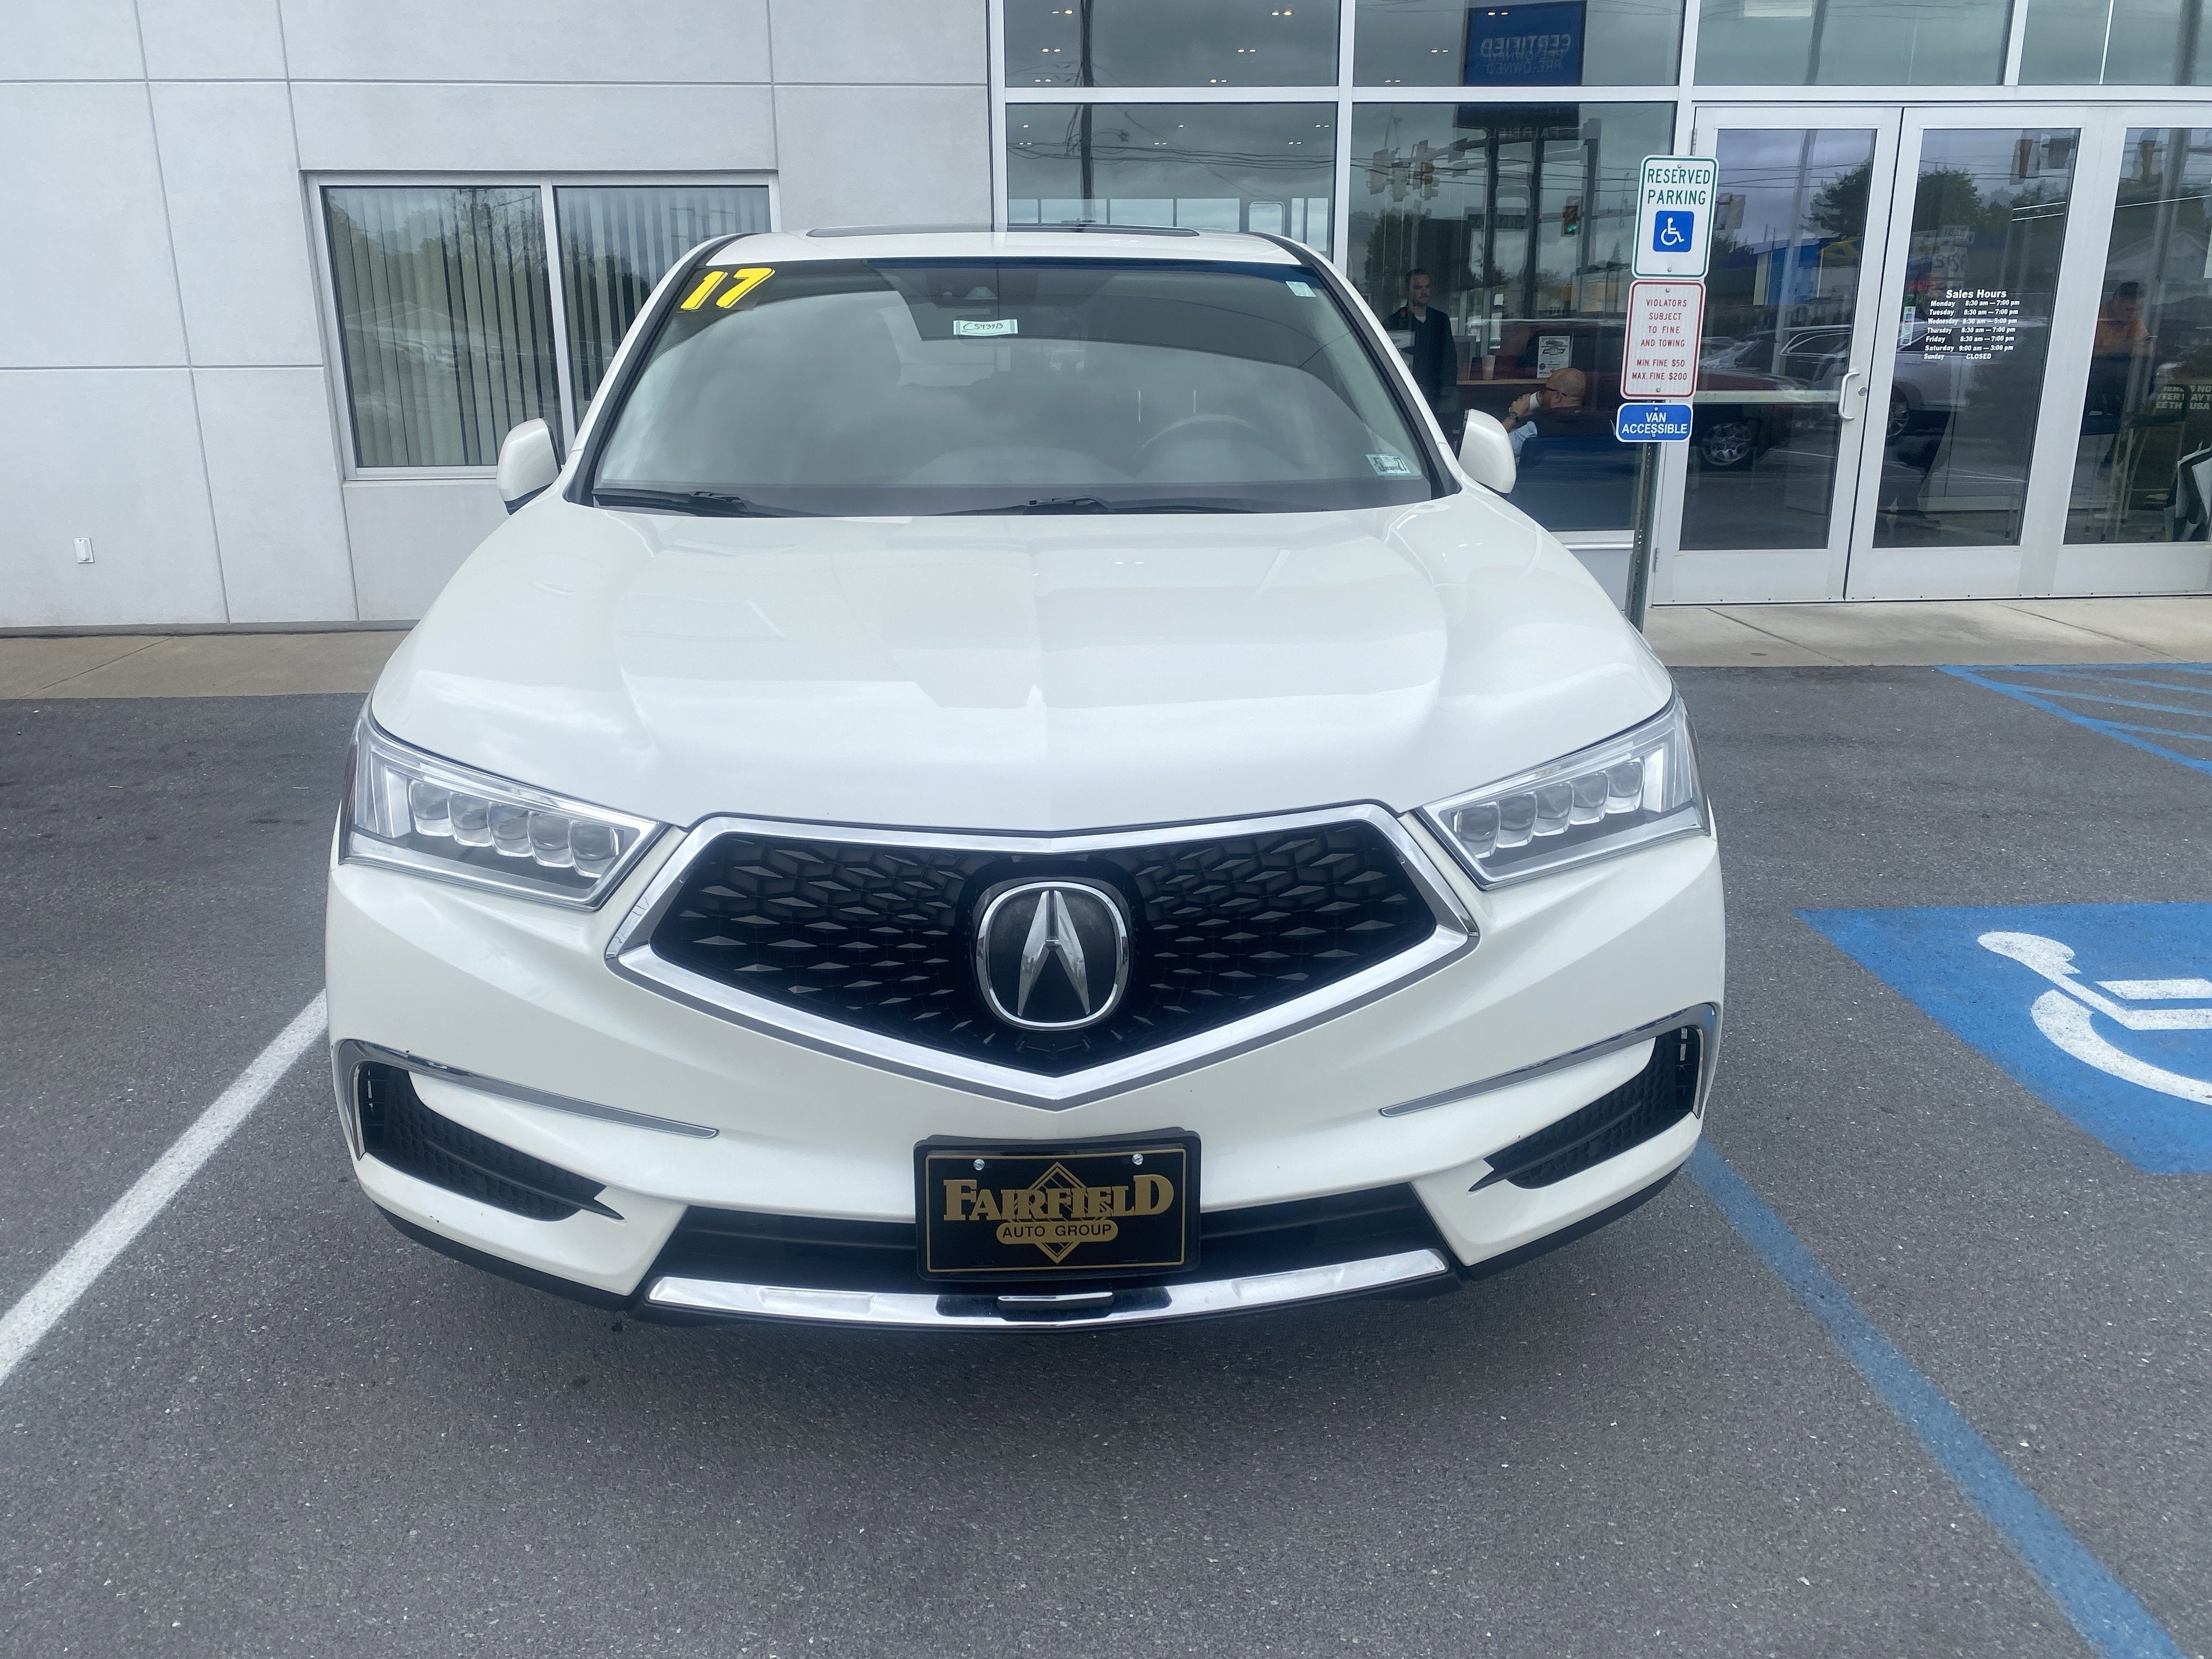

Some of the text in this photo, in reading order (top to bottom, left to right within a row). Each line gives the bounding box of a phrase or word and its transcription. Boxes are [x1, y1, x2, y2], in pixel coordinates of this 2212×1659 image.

[1647, 168, 1711, 184] RESERVED
[1647, 189, 1706, 205] PARKING
[680, 267, 776, 311] 17
[1945, 289, 2007, 298] Sales Hours
[1646, 299, 1687, 307] VIOLATORS
[1649, 312, 1682, 320] SUBJECT
[1929, 308, 1955, 317] Tuesday
[1662, 326, 1680, 334] FINE
[1658, 339, 1685, 347] TOWING
[1672, 359, 1685, 367] $50
[1646, 412, 1667, 422] VAN
[1621, 423, 1688, 434] ACCESSIBLE
[943, 1173, 1174, 1221] FAIRFIELD
[1002, 1223, 1112, 1239] AUTO GROUP
